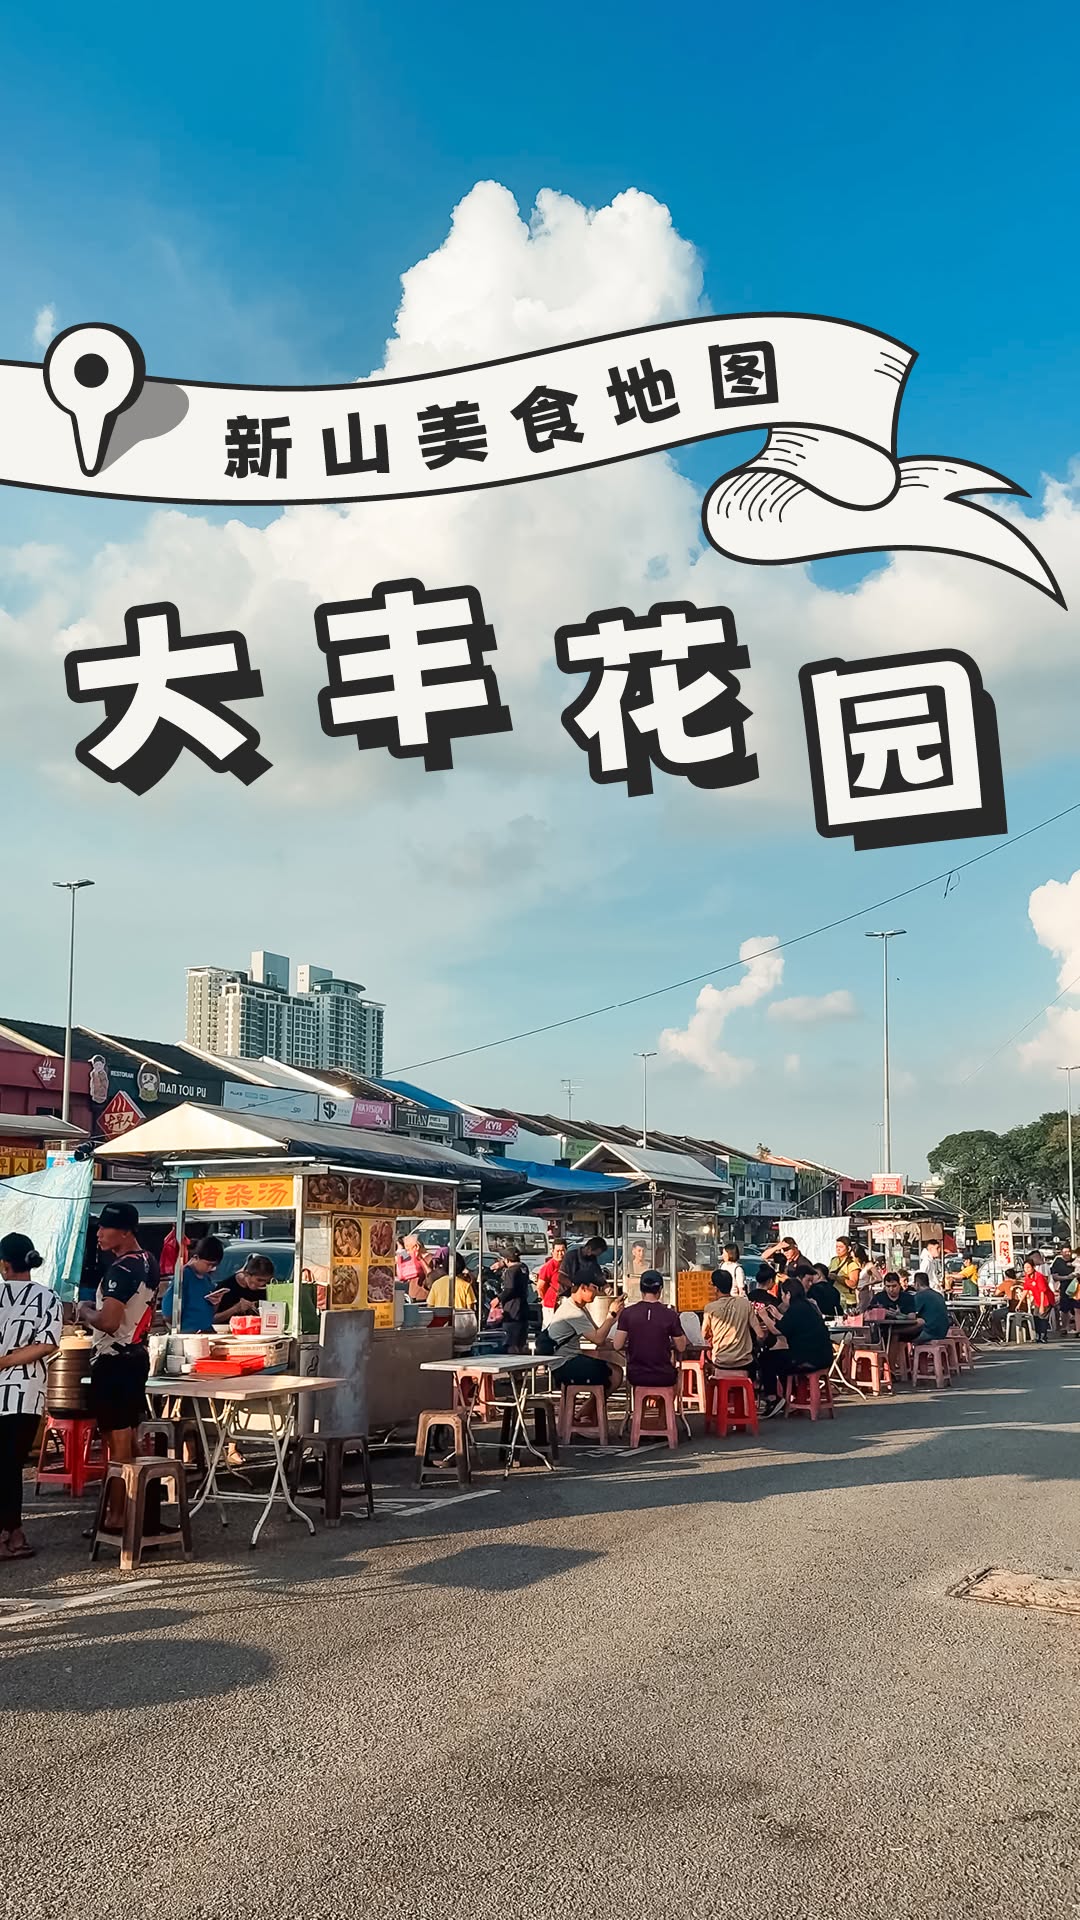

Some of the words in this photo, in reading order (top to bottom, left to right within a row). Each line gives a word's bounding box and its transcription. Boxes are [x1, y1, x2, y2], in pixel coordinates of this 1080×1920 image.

[178, 1084, 194, 1097] TOU
[196, 1086, 207, 1098] PU
[355, 1103, 385, 1114] HIKVISION
[406, 1113, 428, 1126] TITAN
[485, 1120, 502, 1131] KYB
[192, 1182, 289, 1208] 猪杂汤
